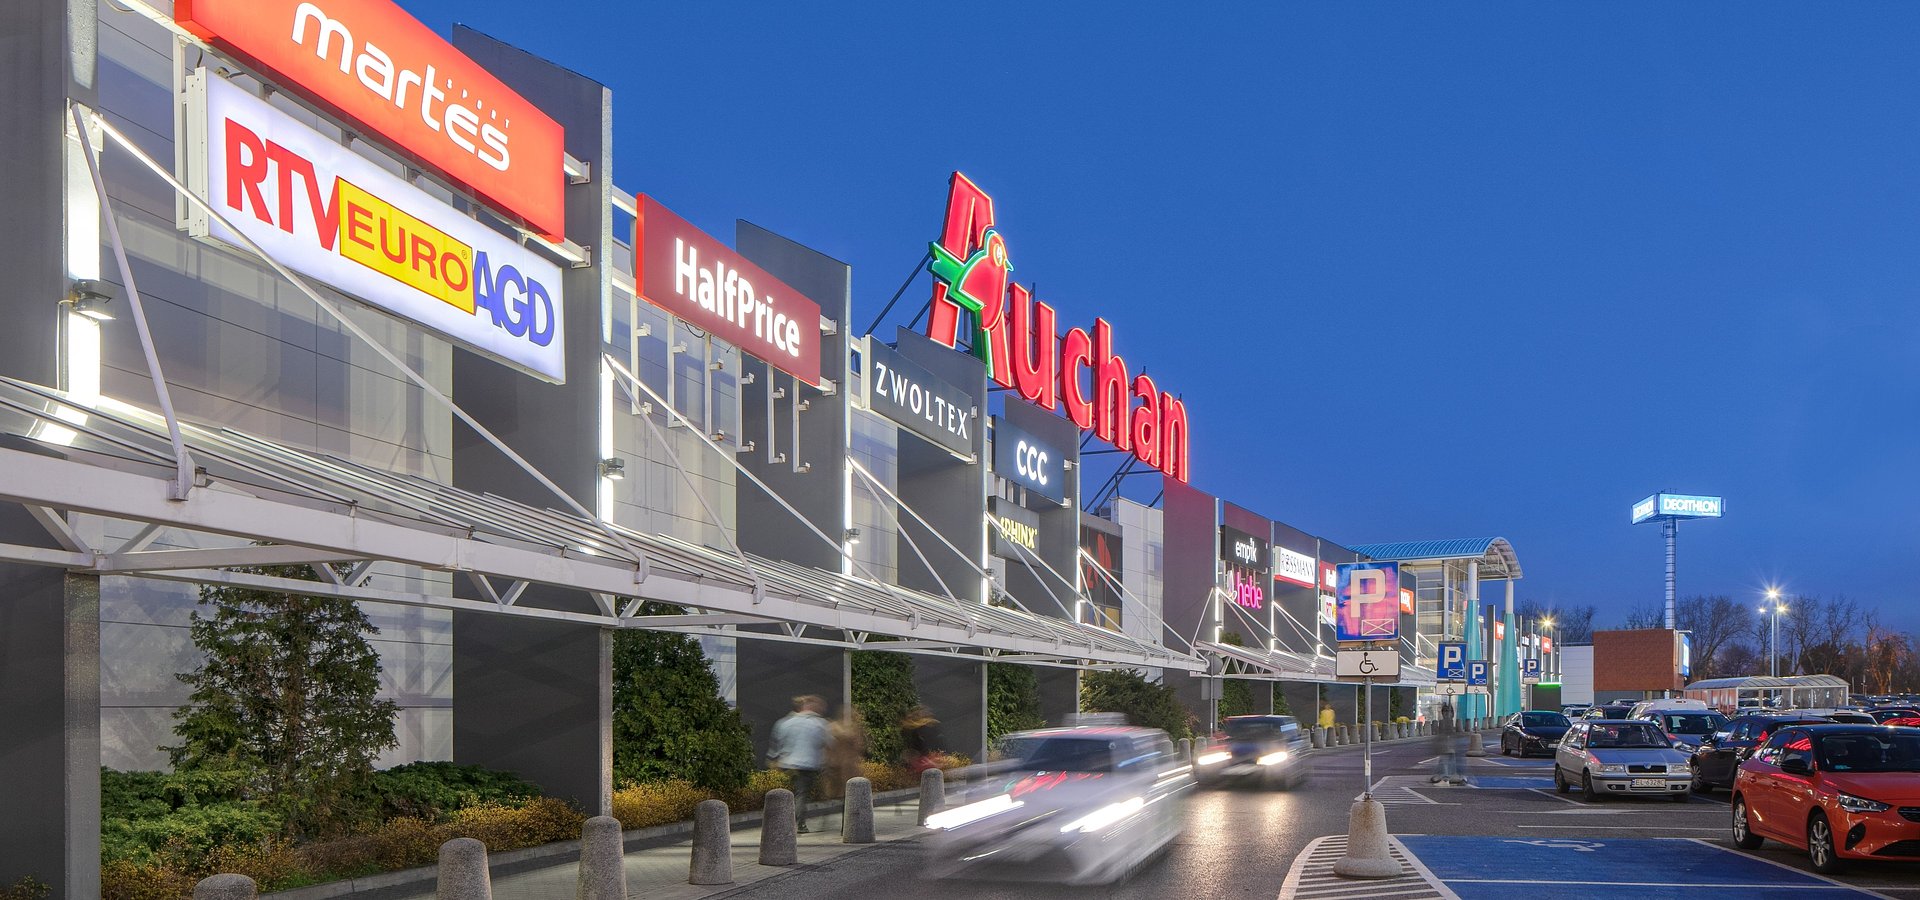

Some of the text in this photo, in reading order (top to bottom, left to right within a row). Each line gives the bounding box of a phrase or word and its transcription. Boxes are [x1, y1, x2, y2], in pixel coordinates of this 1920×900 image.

[291, 2, 511, 172] martes
[225, 117, 555, 347] RTV EURO AGD
[675, 237, 801, 358] HalfPrice
[926, 171, 1189, 484] Auchan
[875, 361, 968, 440] ZWOLTEX
[1016, 440, 1048, 486] CCC
[1663, 498, 1718, 513] DECATHLON
[1235, 537, 1257, 564] empik
[1236, 571, 1263, 610] hebe
[1350, 569, 1386, 618] P
[1443, 646, 1462, 669] P
[1472, 663, 1484, 679] P
[1527, 660, 1537, 672] P
